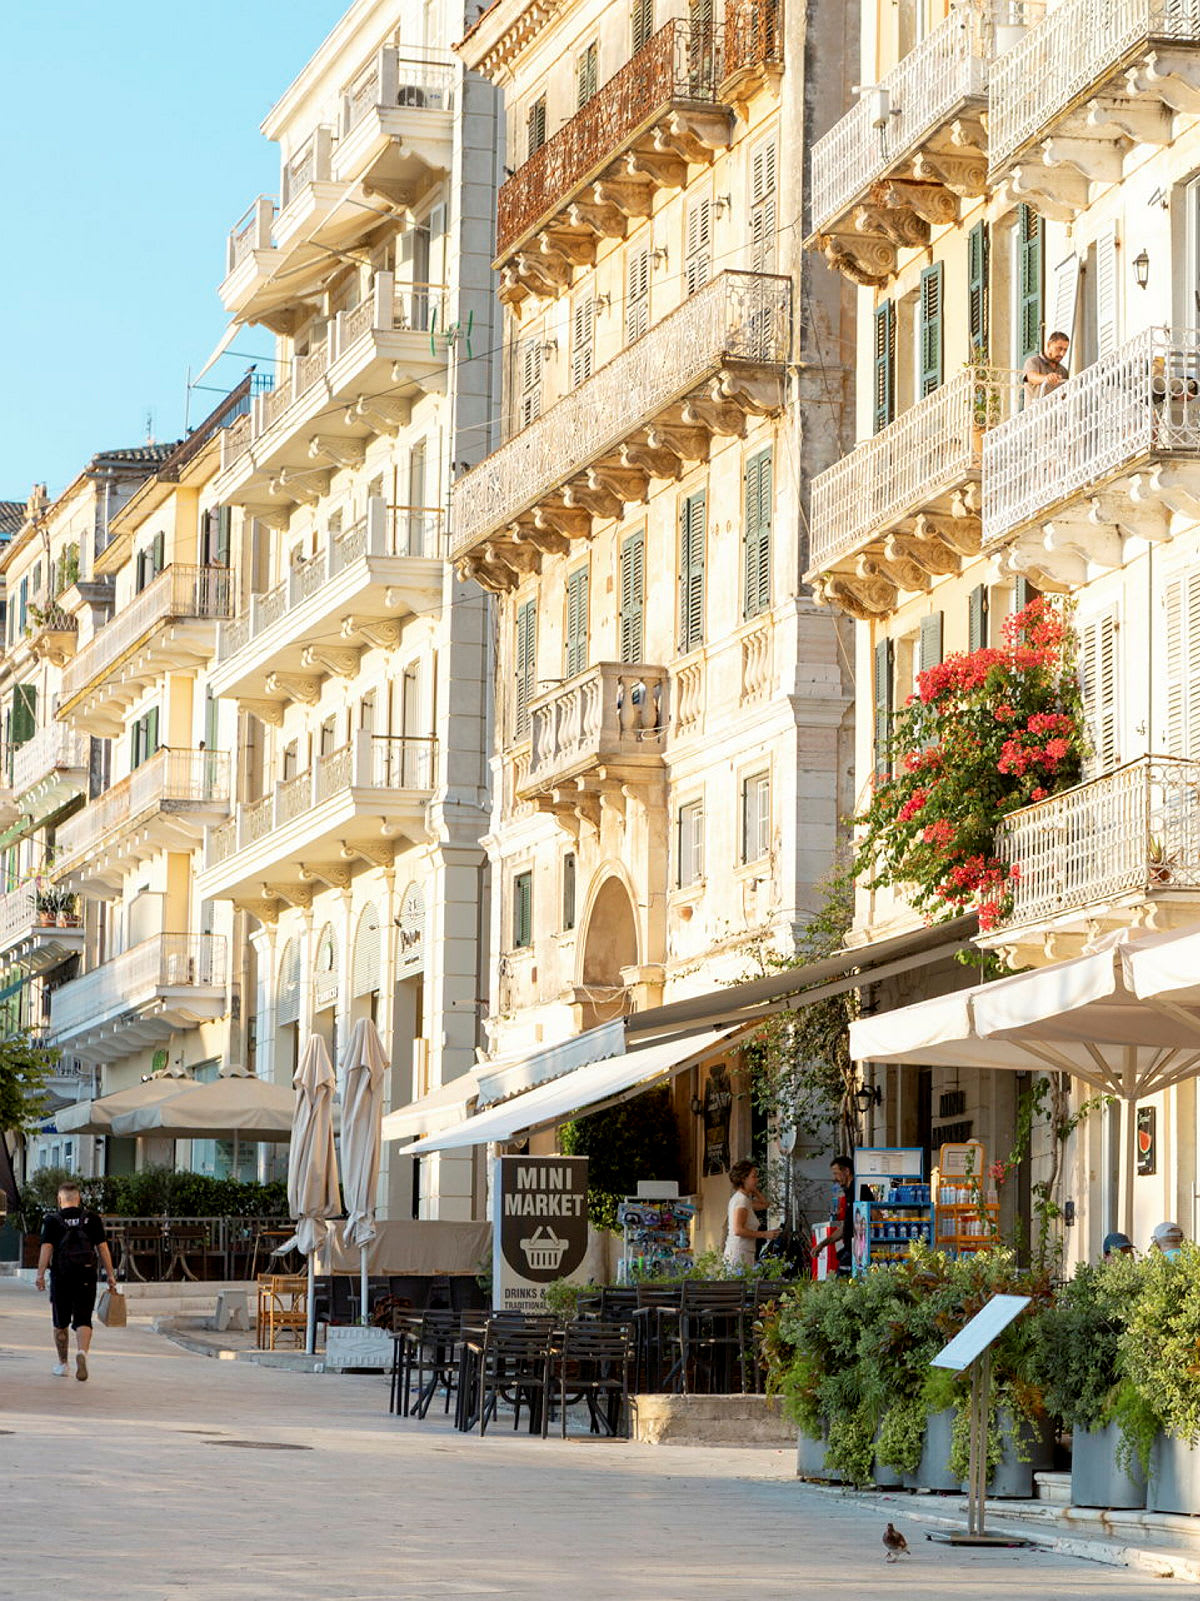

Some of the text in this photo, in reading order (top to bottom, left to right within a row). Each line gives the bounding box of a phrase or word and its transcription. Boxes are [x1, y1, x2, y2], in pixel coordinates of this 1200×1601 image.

[517, 1167, 572, 1190] MINI
[505, 1194, 584, 1217] MARKET
[505, 1288, 537, 1299] DRINKS
